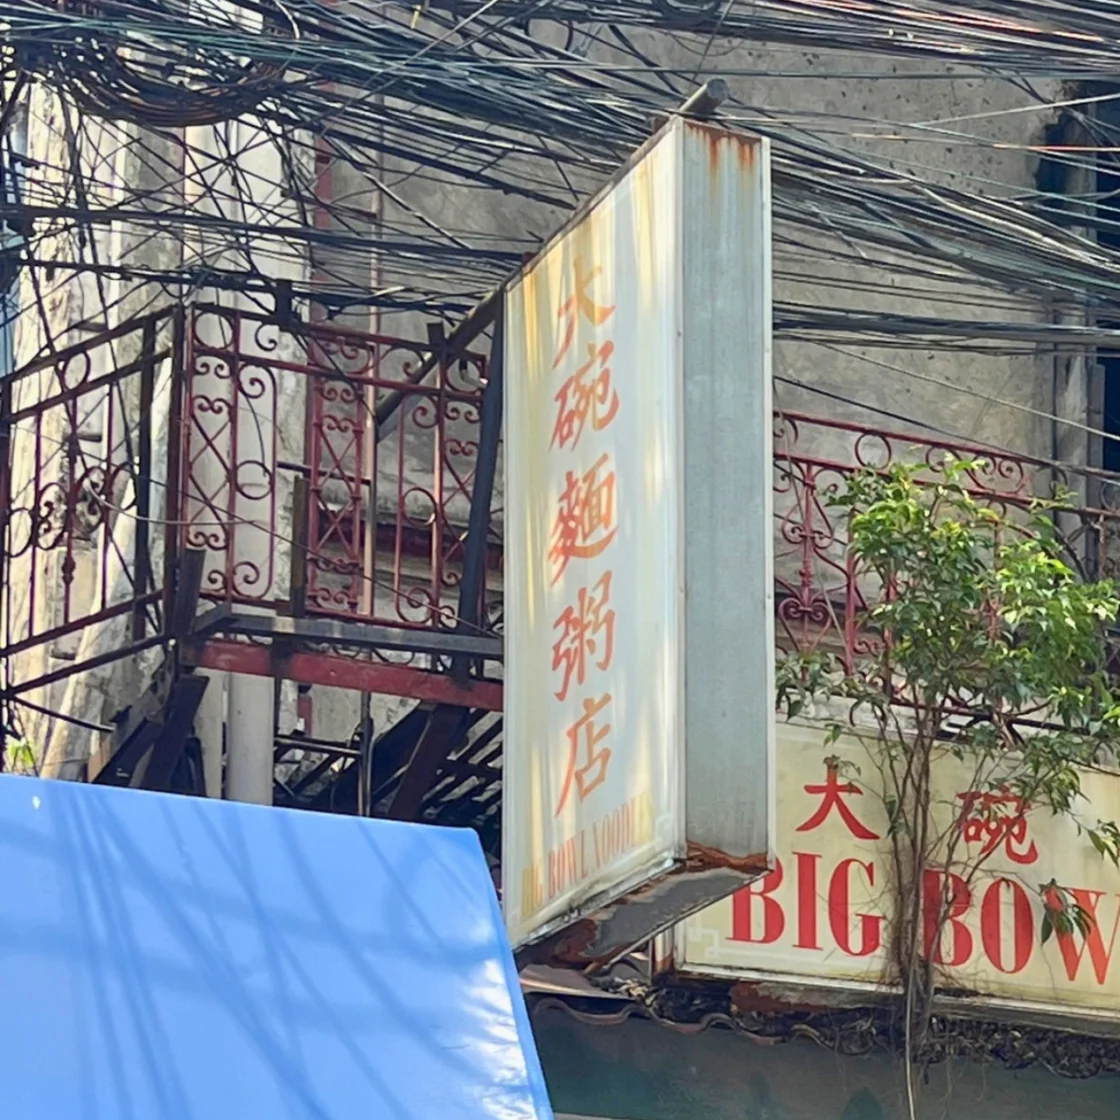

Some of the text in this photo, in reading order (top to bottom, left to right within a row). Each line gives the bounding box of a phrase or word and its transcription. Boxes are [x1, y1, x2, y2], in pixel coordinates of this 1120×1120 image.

[549, 256, 620, 820] 大碗麵粥店
[725, 851, 887, 957] BIG
